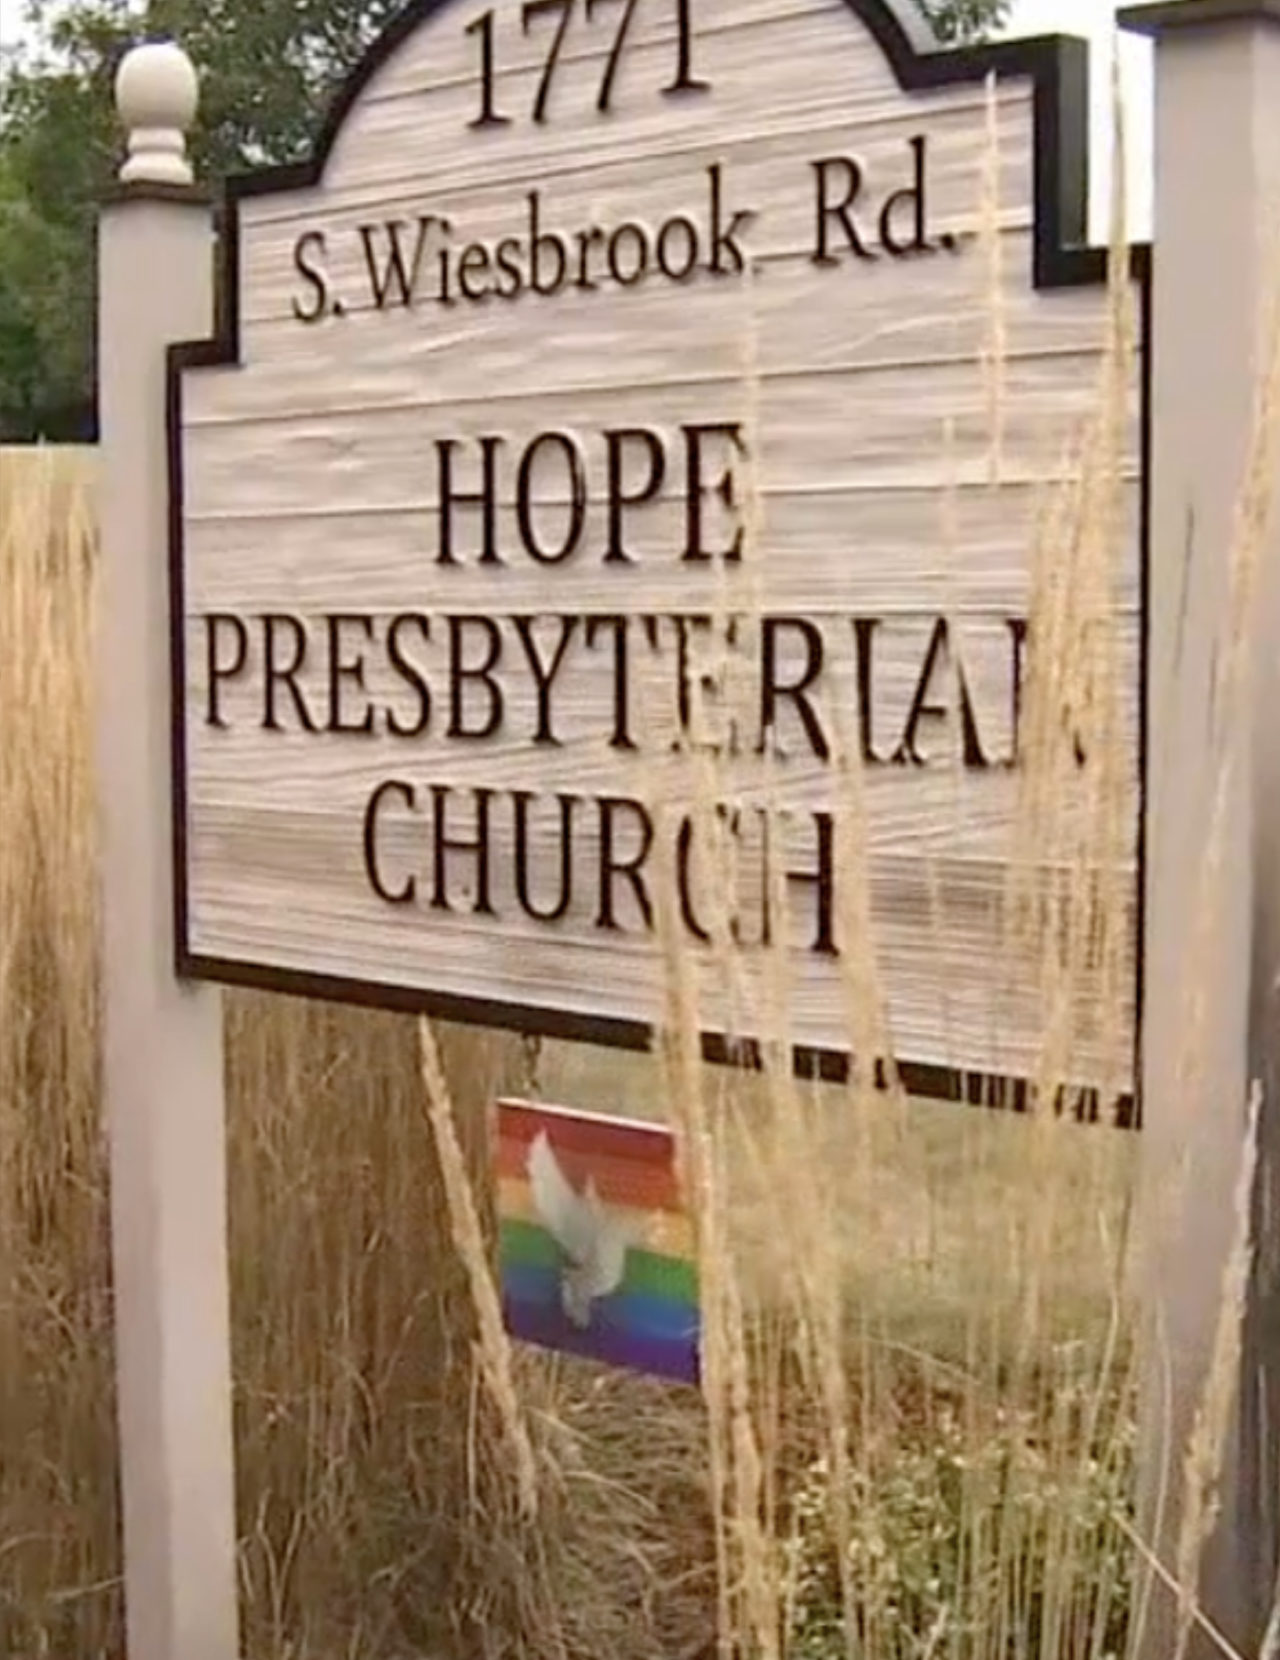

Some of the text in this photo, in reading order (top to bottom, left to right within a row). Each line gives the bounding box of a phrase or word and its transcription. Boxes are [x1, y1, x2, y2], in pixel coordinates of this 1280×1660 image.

[464, 0, 712, 130] 1771
[357, 164, 759, 310] Wiesbrook
[810, 135, 958, 268] Rd.
[434, 423, 748, 564] HOPE
